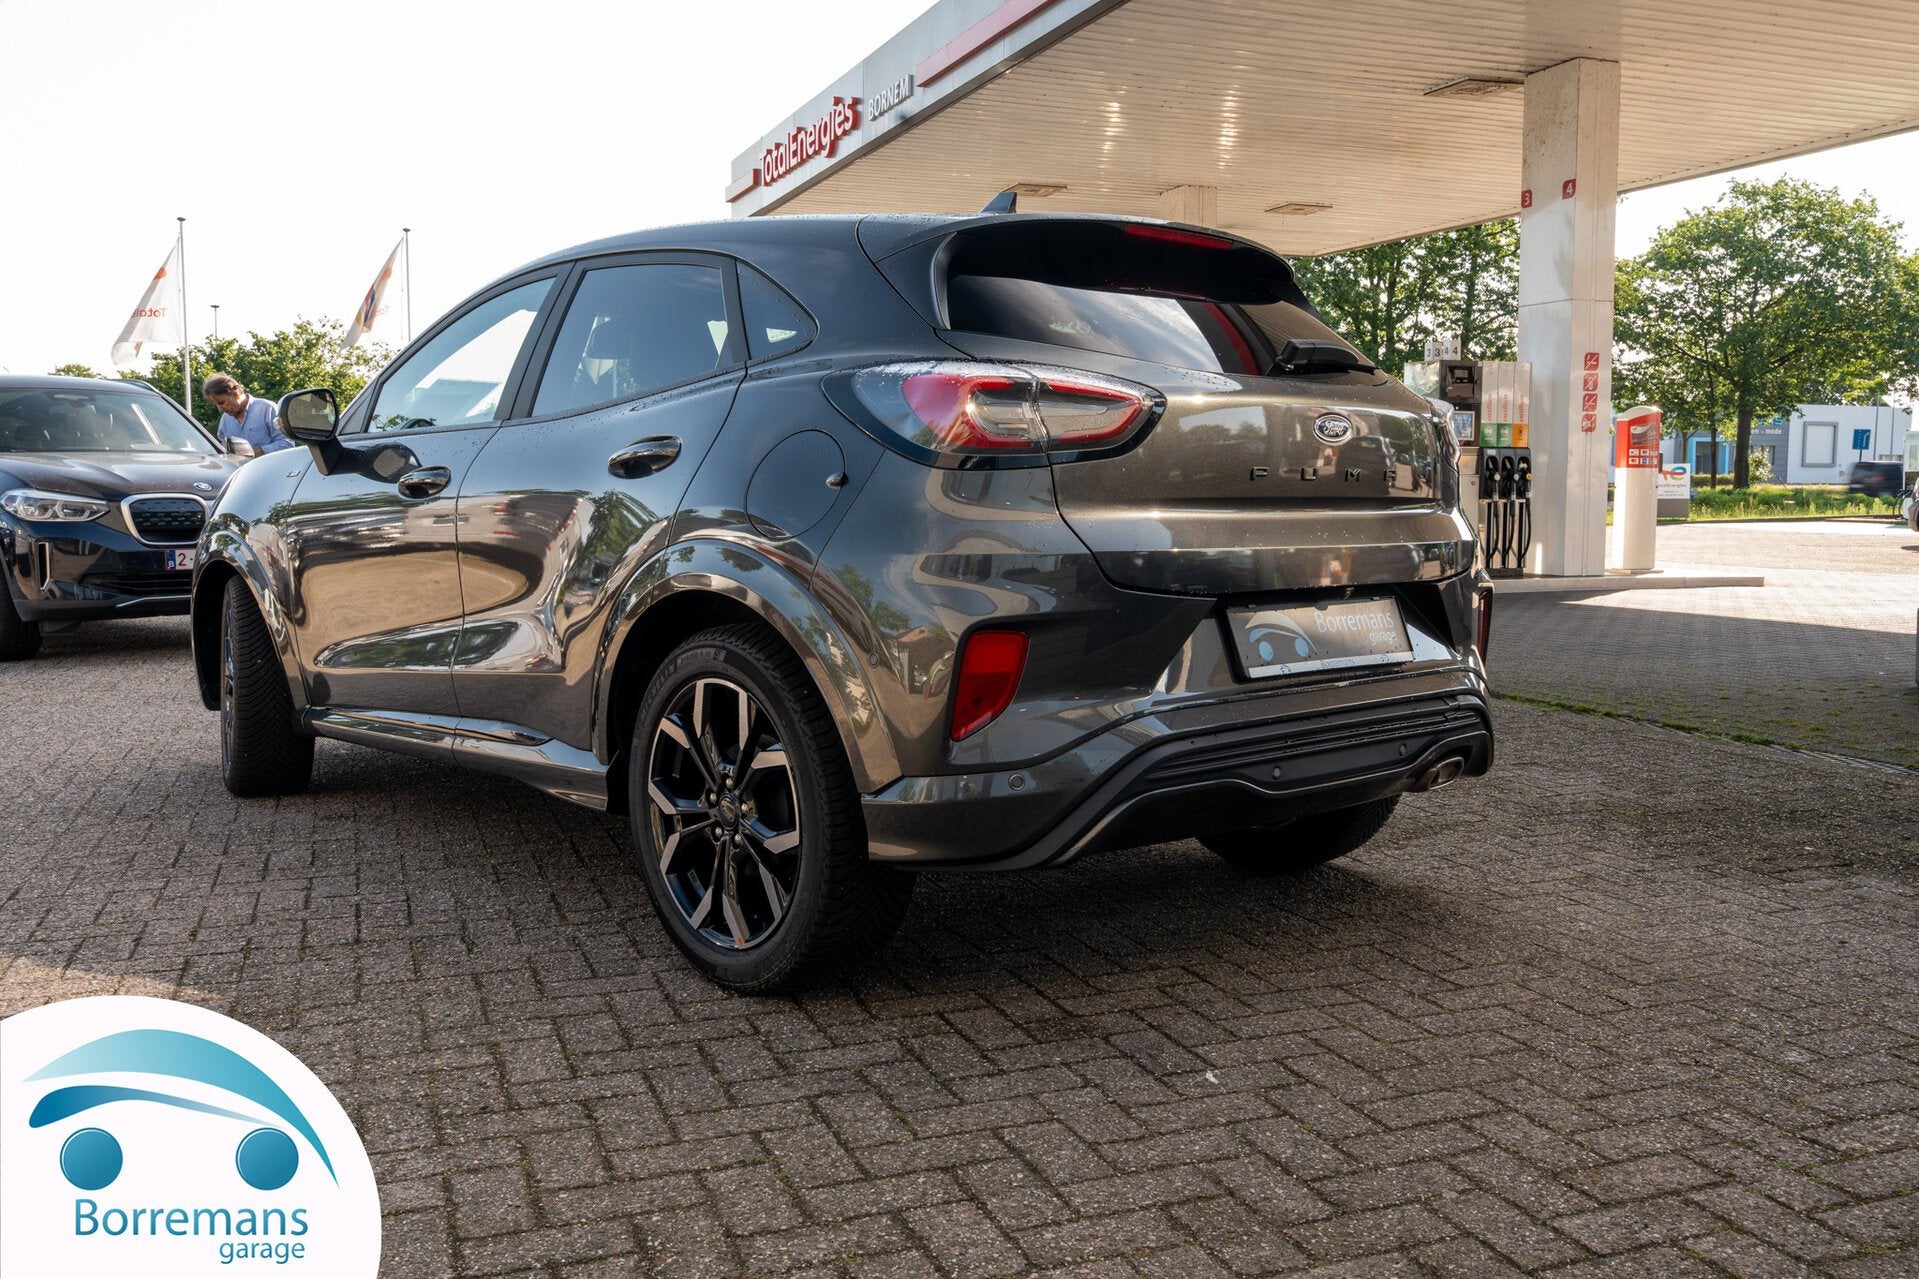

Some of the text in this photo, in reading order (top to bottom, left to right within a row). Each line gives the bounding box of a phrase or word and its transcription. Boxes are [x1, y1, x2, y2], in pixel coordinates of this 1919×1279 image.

[759, 74, 914, 187] TotalEnergies BORNEM
[1566, 182, 1574, 195] 4
[1524, 192, 1530, 206] 3
[168, 560, 175, 568] B
[1314, 611, 1395, 633] Borremans
[1369, 631, 1397, 645] garage
[1320, 658, 1356, 669] Borremans
